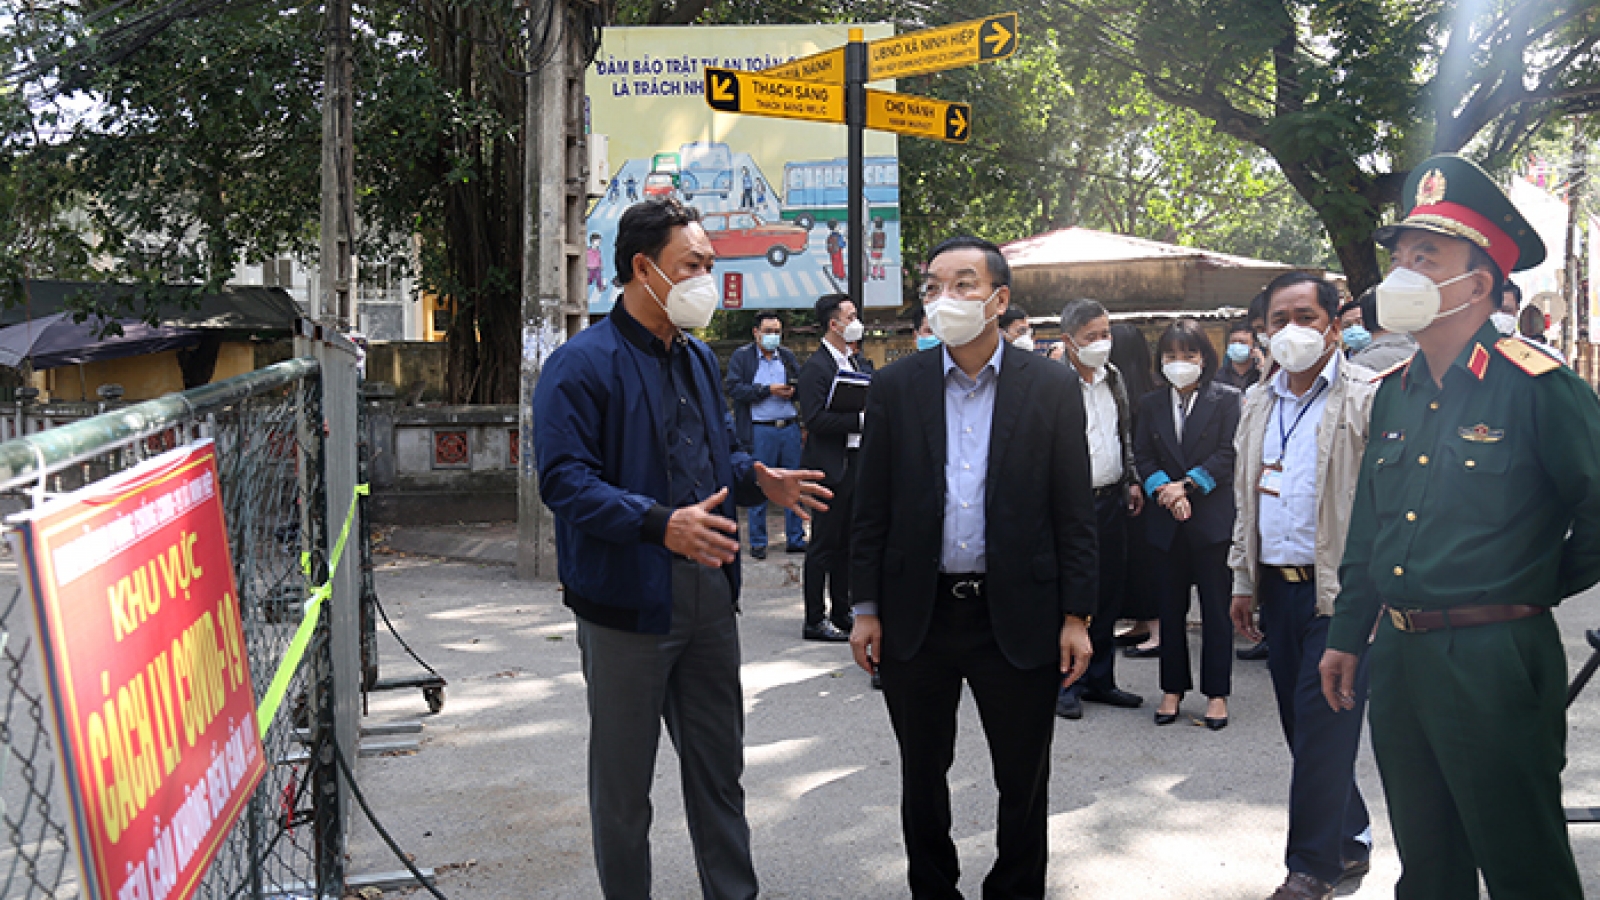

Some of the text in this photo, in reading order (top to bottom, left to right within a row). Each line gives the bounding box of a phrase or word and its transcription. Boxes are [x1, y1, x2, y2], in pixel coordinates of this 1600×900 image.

[612, 77, 630, 96] LÀ
[107, 559, 161, 643] KHU
[157, 530, 204, 601] VỰC
[87, 670, 163, 845] CÁCH
[146, 650, 182, 777] LY
[171, 592, 243, 748] COVID-19
